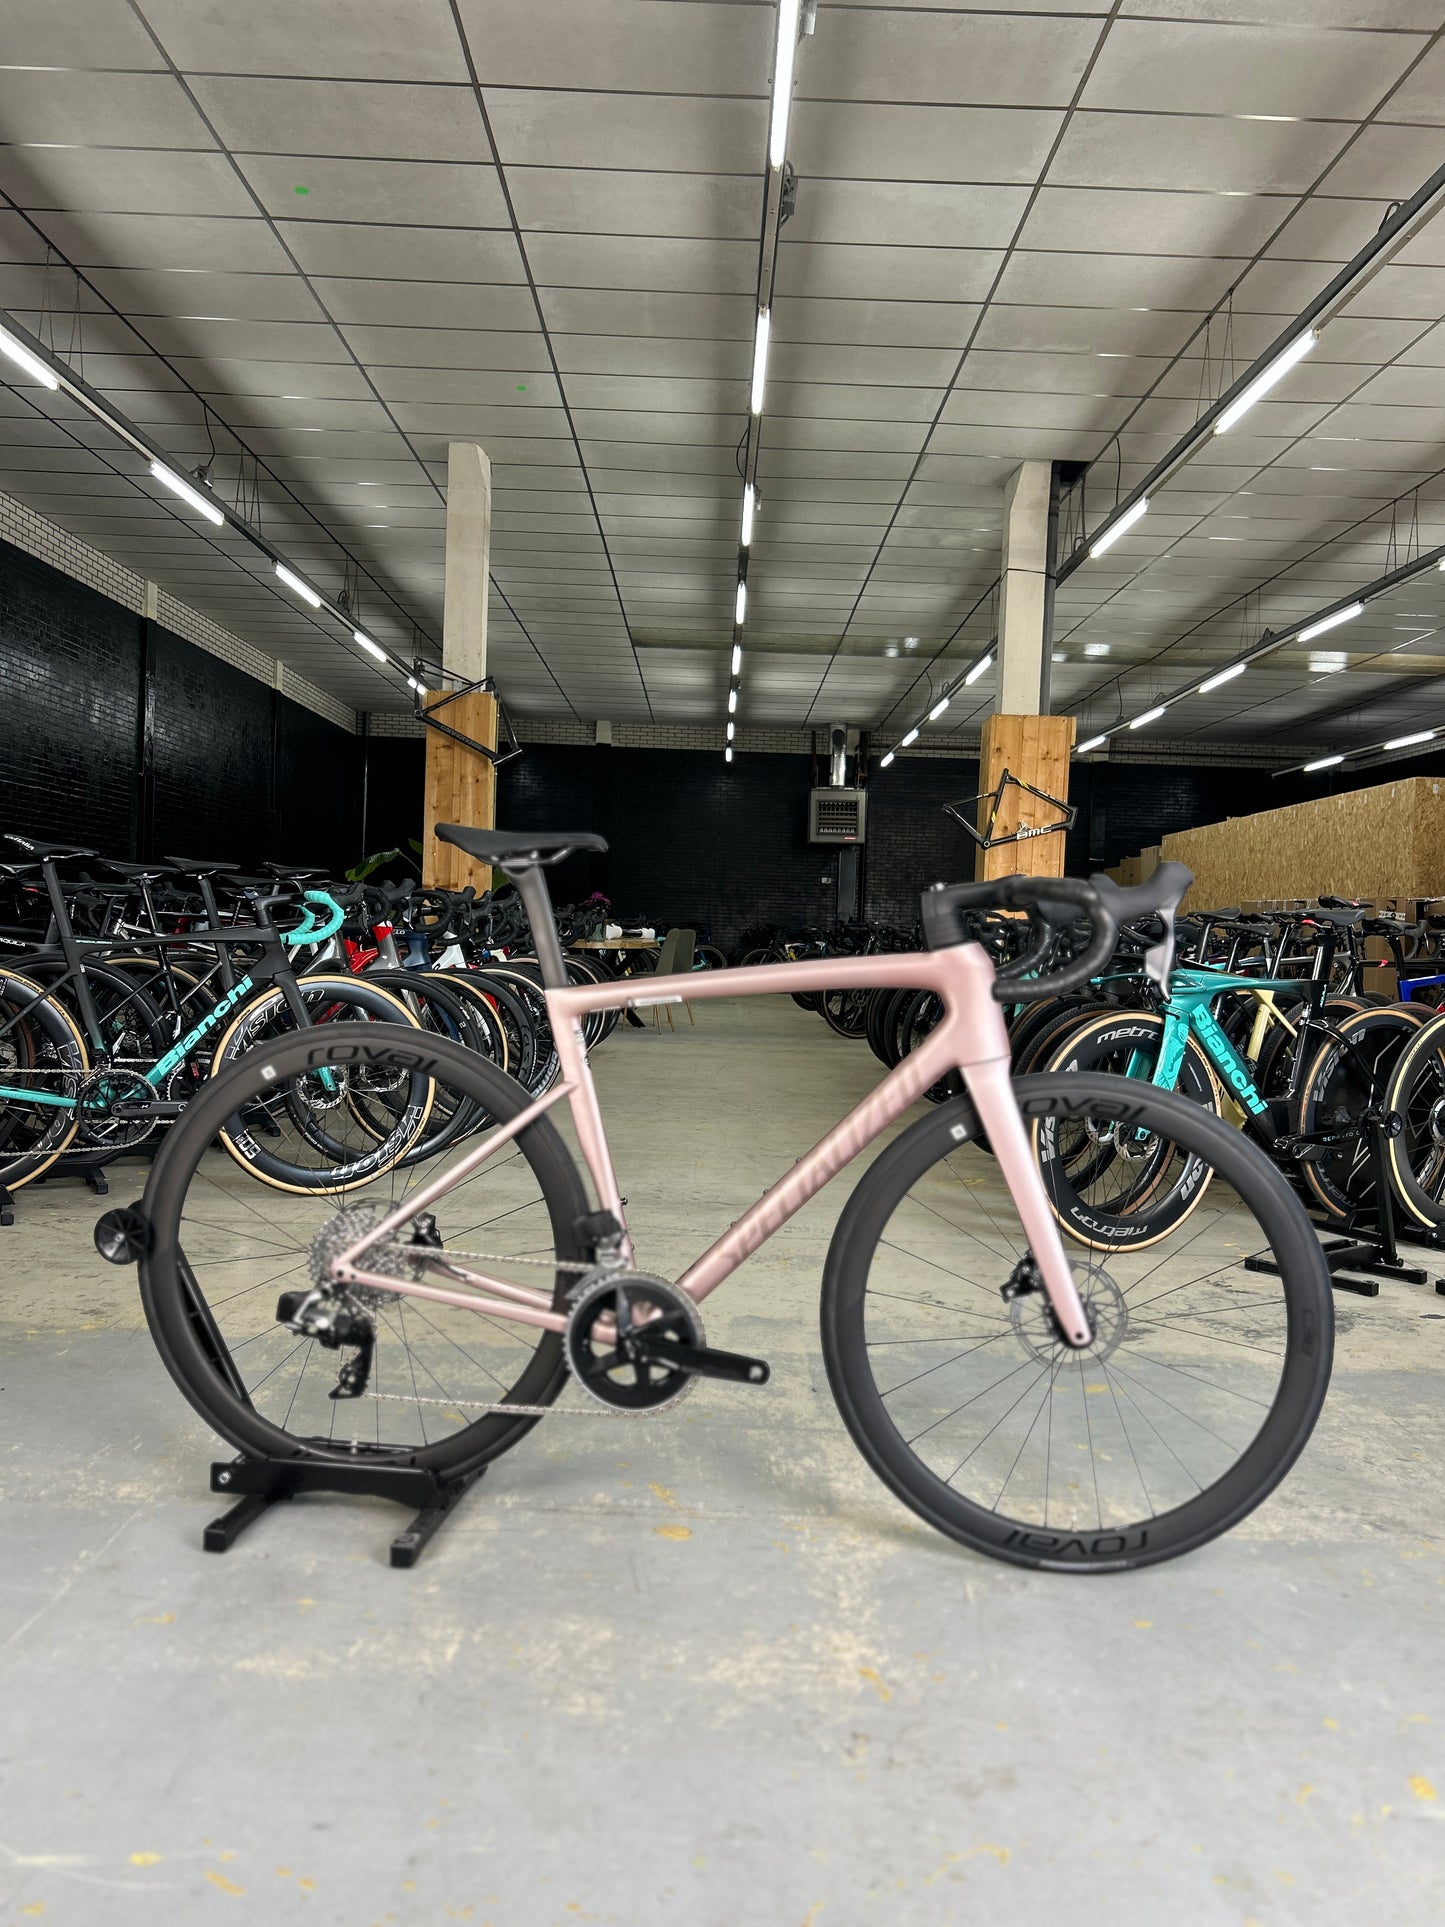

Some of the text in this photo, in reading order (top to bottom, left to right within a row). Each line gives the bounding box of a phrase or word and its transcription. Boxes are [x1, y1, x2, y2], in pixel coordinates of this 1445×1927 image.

[155, 974, 254, 1077] Bianchi
[1096, 1025, 1163, 1045] metro
[307, 1045, 440, 1072] roval
[1191, 1003, 1269, 1115] Bianchi
[1022, 1096, 1148, 1120] oval
[1070, 1206, 1149, 1238] metron
[1003, 1529, 1149, 1556] roval
